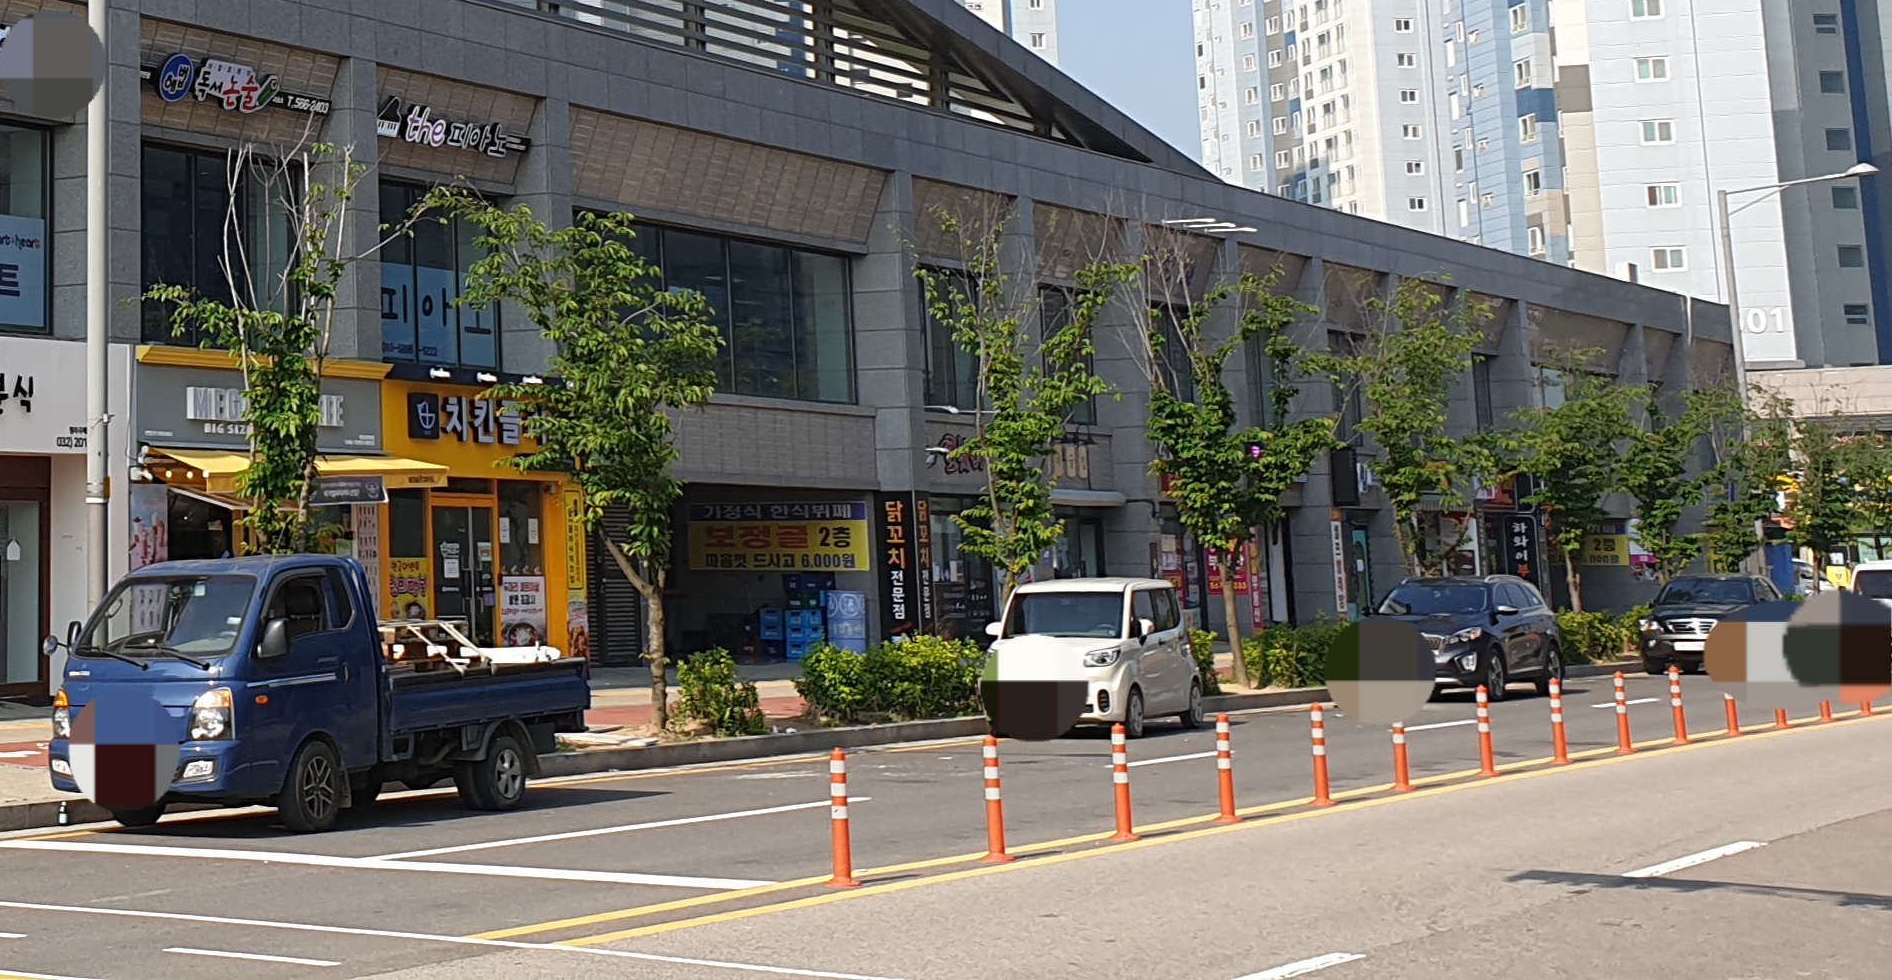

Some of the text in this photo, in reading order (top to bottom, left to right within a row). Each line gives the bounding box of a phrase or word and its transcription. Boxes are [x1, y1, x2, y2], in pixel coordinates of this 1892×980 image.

[406, 105, 508, 158] the 피아노
[1740, 307, 1786, 334] 01
[186, 386, 248, 421] MEG
[203, 423, 225, 435] BIG
[445, 395, 549, 445] 치킨플
[703, 502, 762, 520] 가정식
[818, 526, 852, 549] 2층
[704, 552, 748, 569] 마음껏
[752, 552, 796, 569] 드시고
